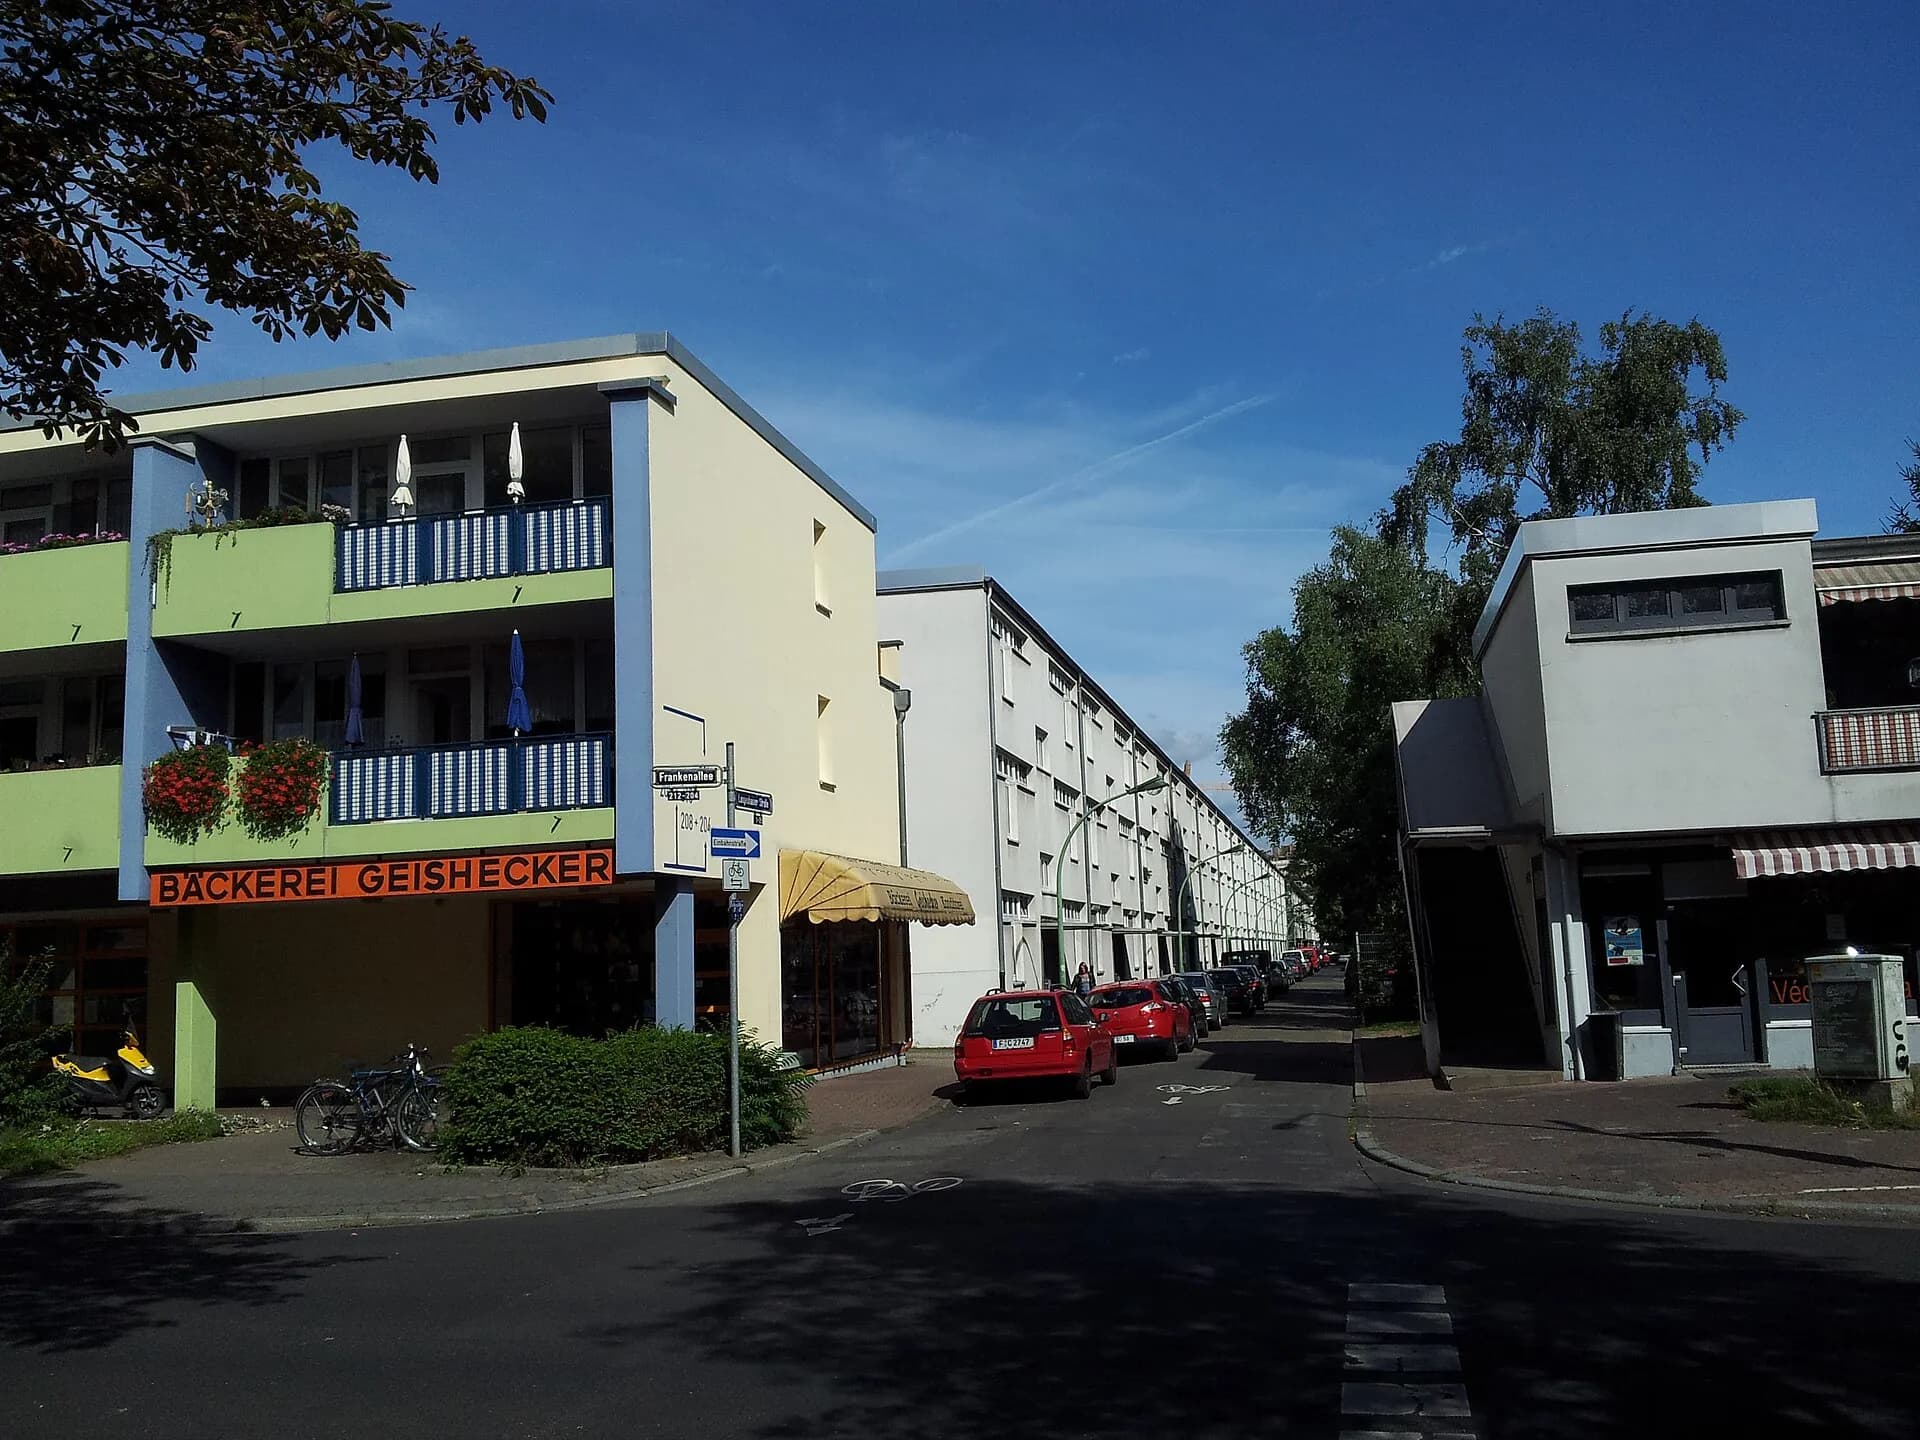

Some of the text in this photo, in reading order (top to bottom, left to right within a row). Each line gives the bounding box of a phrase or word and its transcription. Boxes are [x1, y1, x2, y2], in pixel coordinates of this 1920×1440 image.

[659, 771, 714, 782] Frankenallee
[158, 852, 609, 903] BÄCKEREI GEISHECKER
